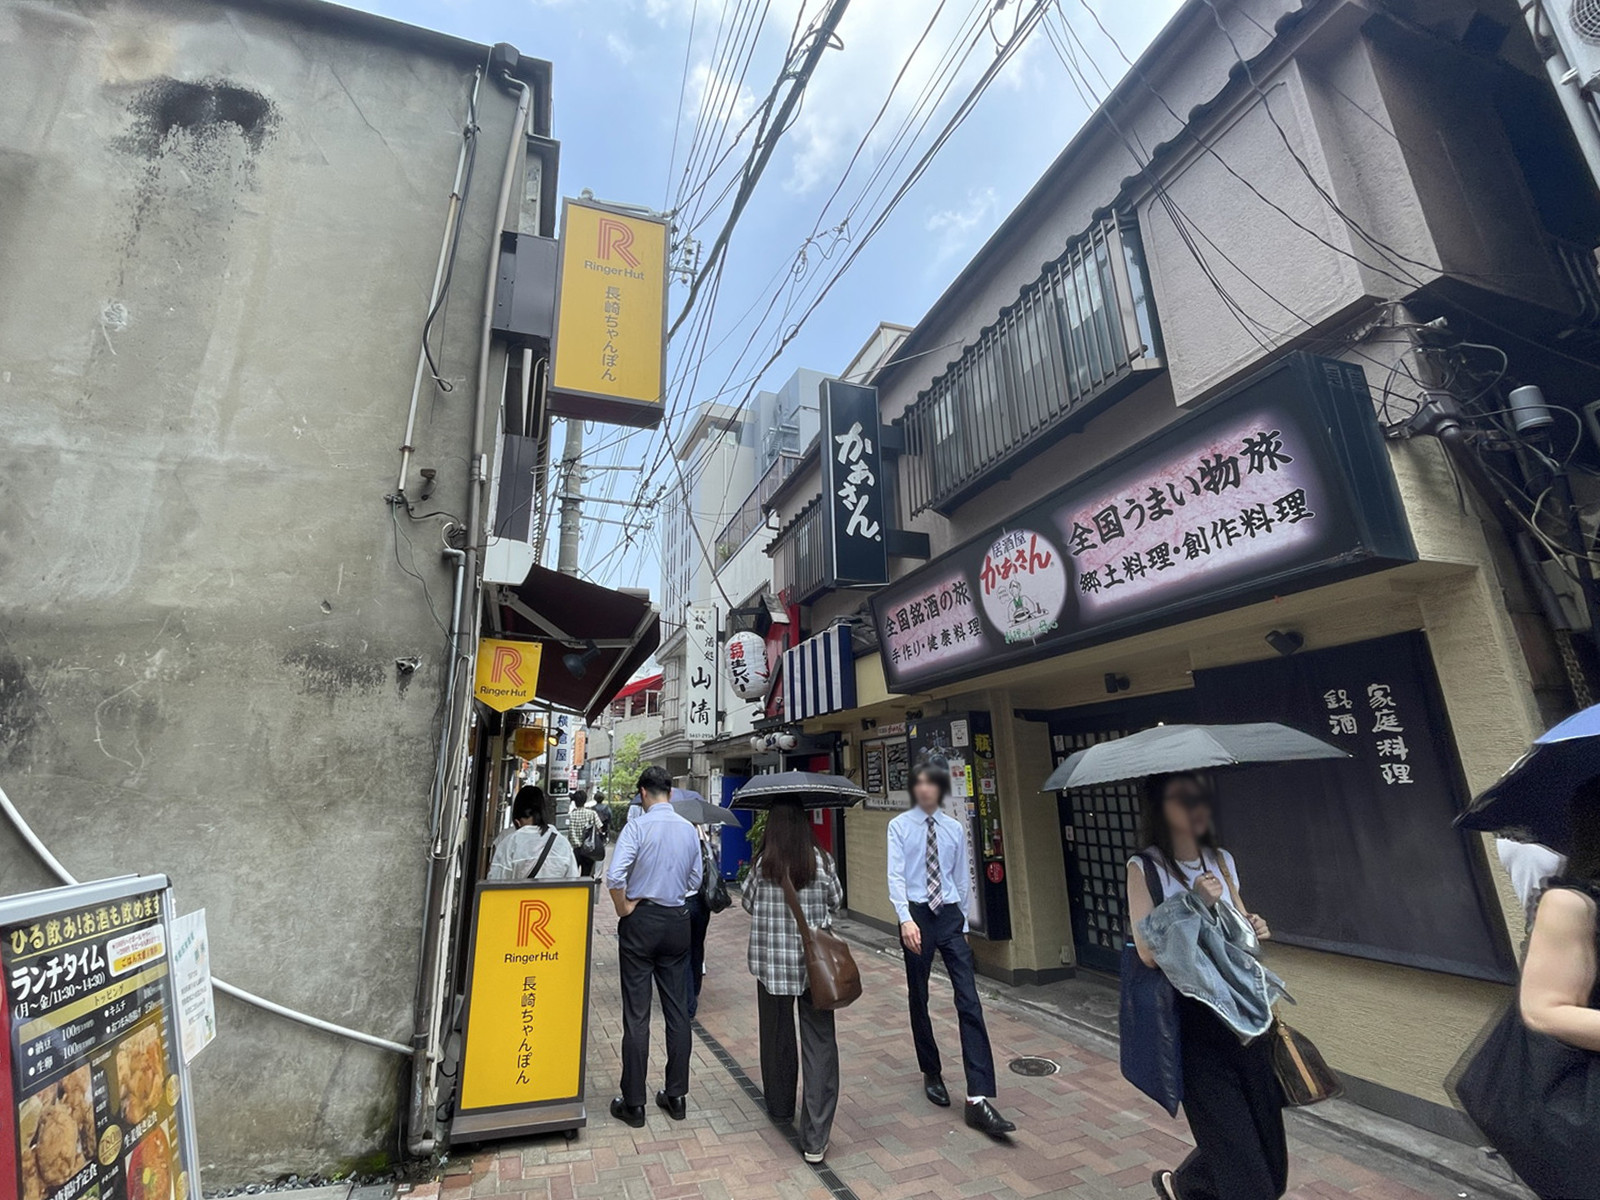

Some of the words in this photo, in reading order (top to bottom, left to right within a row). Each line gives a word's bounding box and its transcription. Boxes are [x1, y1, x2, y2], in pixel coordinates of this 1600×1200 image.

[597, 217, 641, 269] R
[584, 260, 623, 277] Ringer
[624, 267, 645, 281] Hut
[601, 286, 621, 382] 長崎ちゃんぽん
[1068, 430, 1293, 557] 全国うまい物旅
[991, 529, 1027, 560] 居酒屋
[885, 580, 972, 639] 全国銘酒の旅
[480, 686, 510, 697] Ringer
[510, 688, 527, 697] Hut
[491, 646, 525, 688] R
[689, 666, 712, 726] 山清
[1323, 689, 1358, 735] 銘酒
[1367, 683, 1414, 785] 家庭料理
[517, 899, 556, 950] R
[12, 944, 106, 1001] ランチタイム
[504, 952, 540, 965] Ringer
[540, 951, 559, 962] Hut
[94, 984, 124, 1007] トッピング
[110, 1000, 126, 1016] キムチ
[516, 976, 537, 1085] 長崎ちゃんぽん
